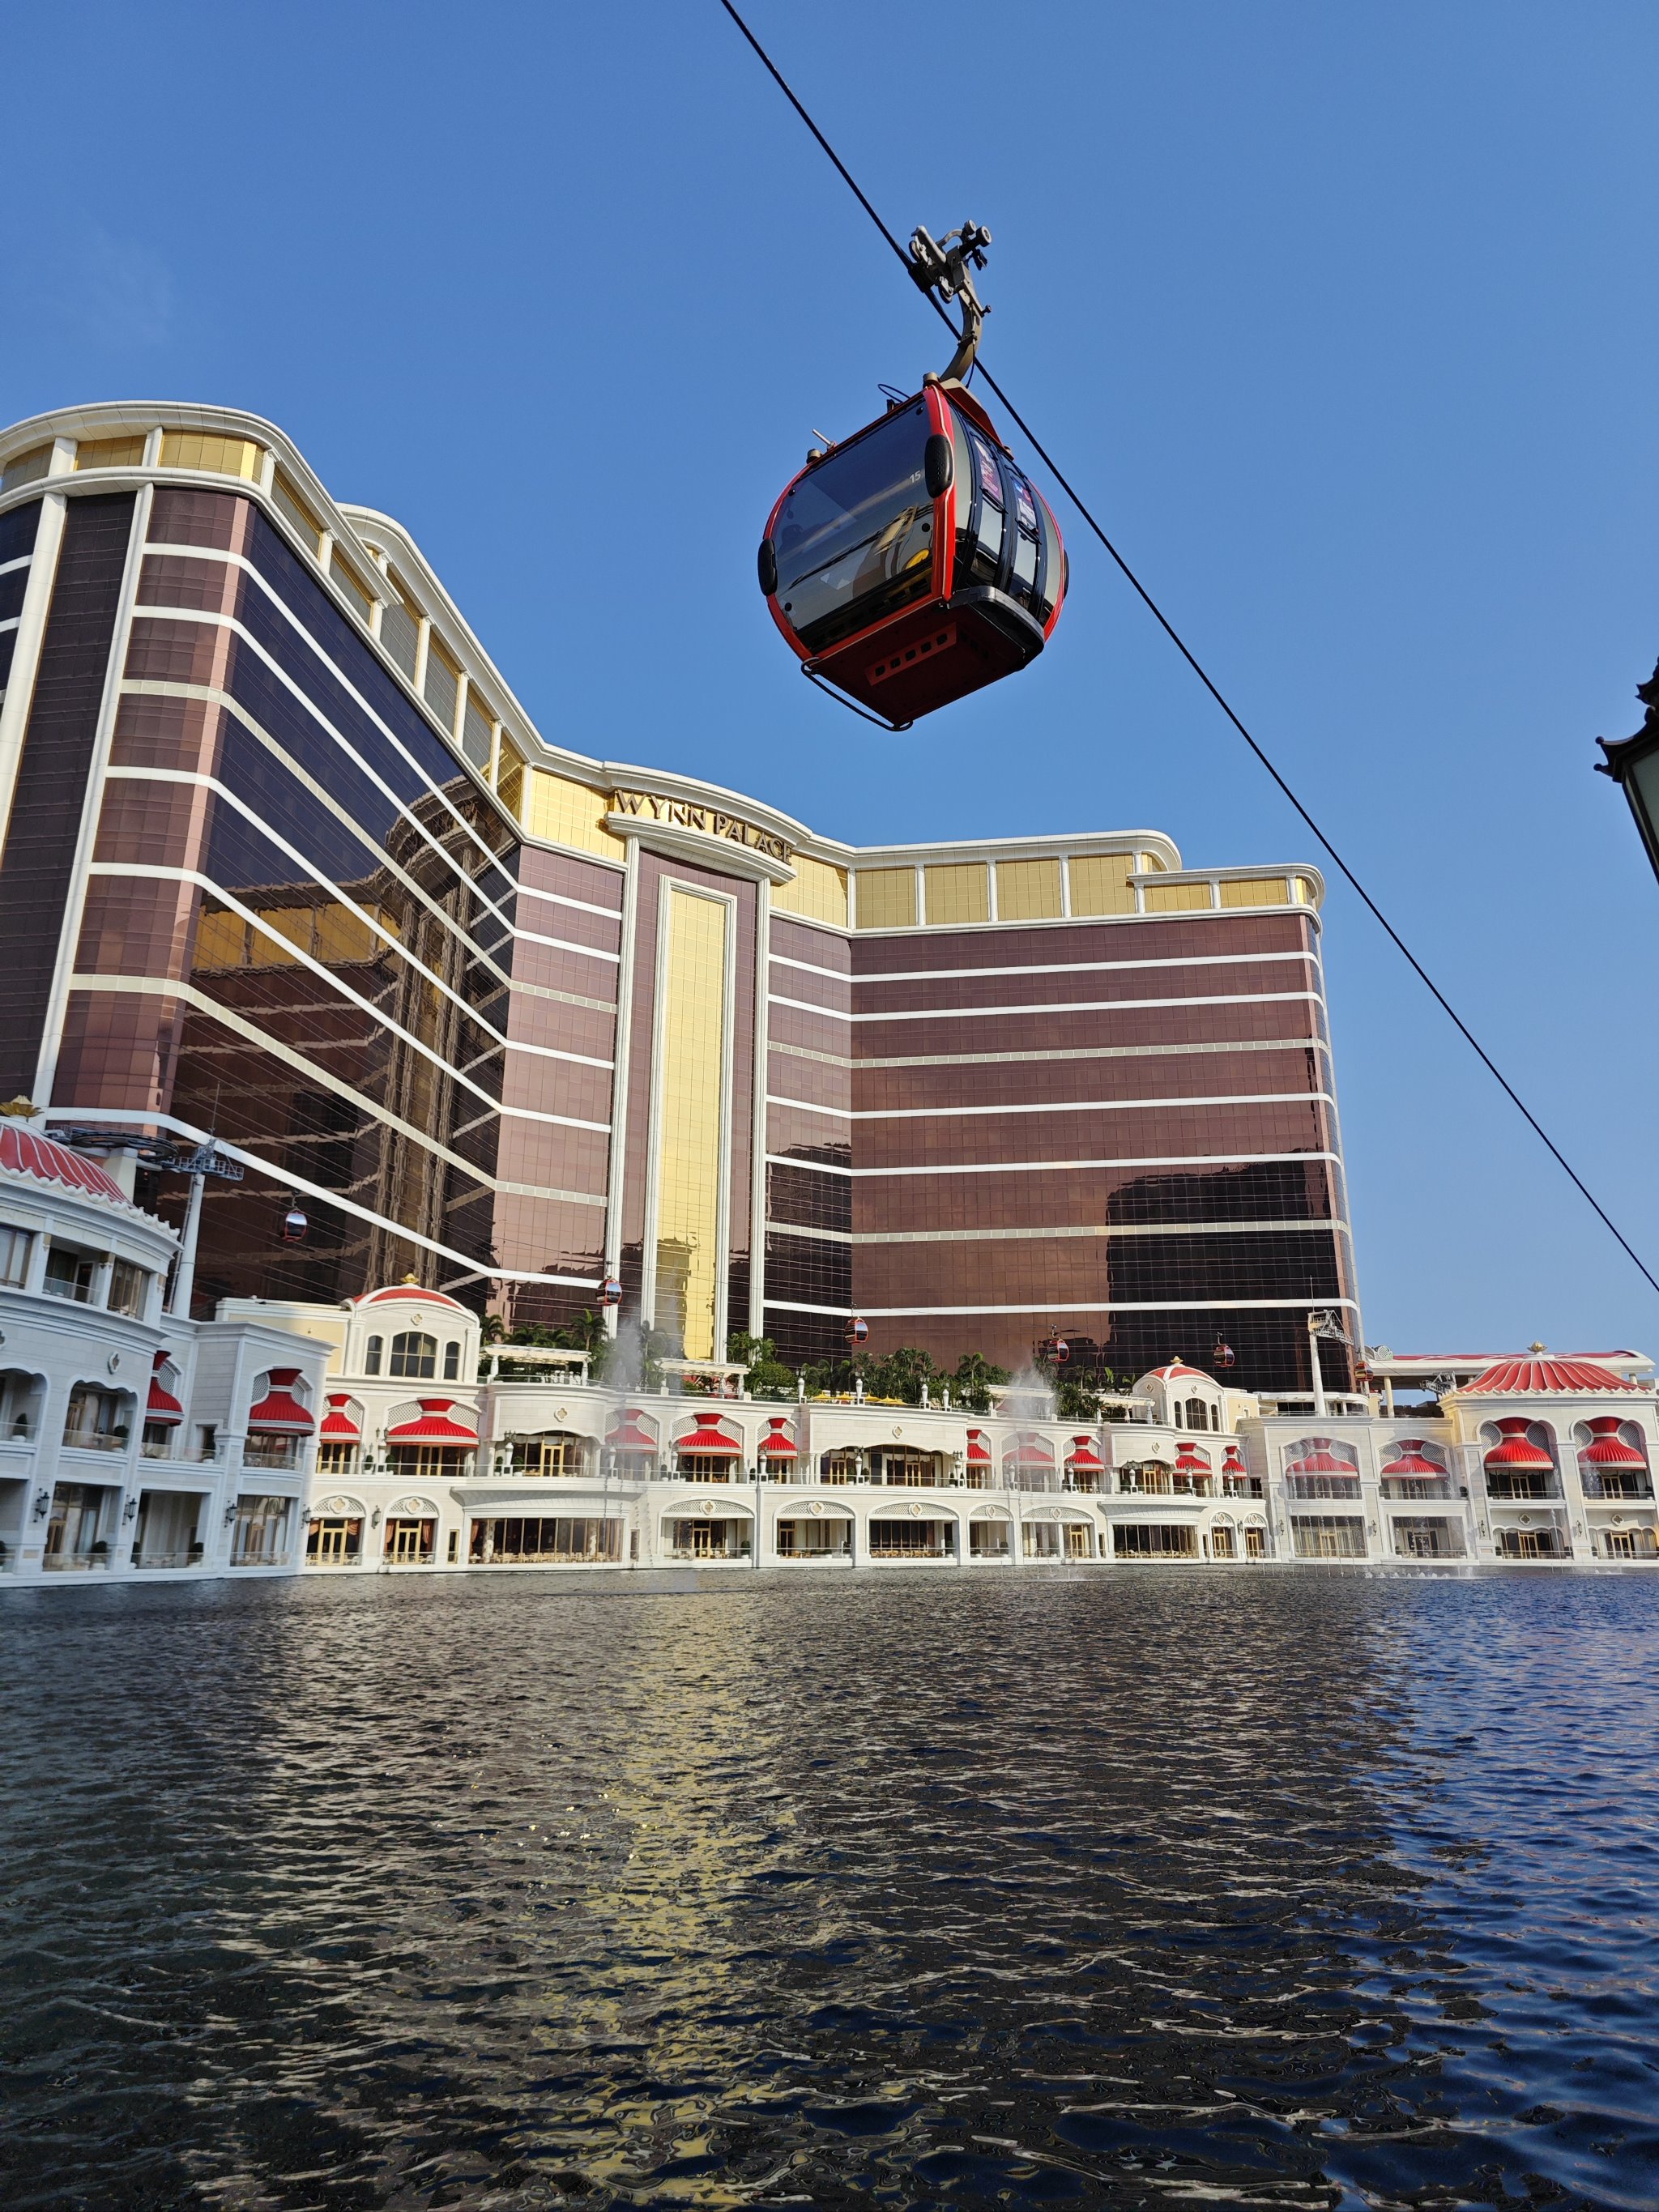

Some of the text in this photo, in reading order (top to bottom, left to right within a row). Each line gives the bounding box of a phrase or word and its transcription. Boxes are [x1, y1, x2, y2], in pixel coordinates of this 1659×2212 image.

[910, 470, 921, 483] 15
[616, 789, 791, 865] WYNN PALACE
